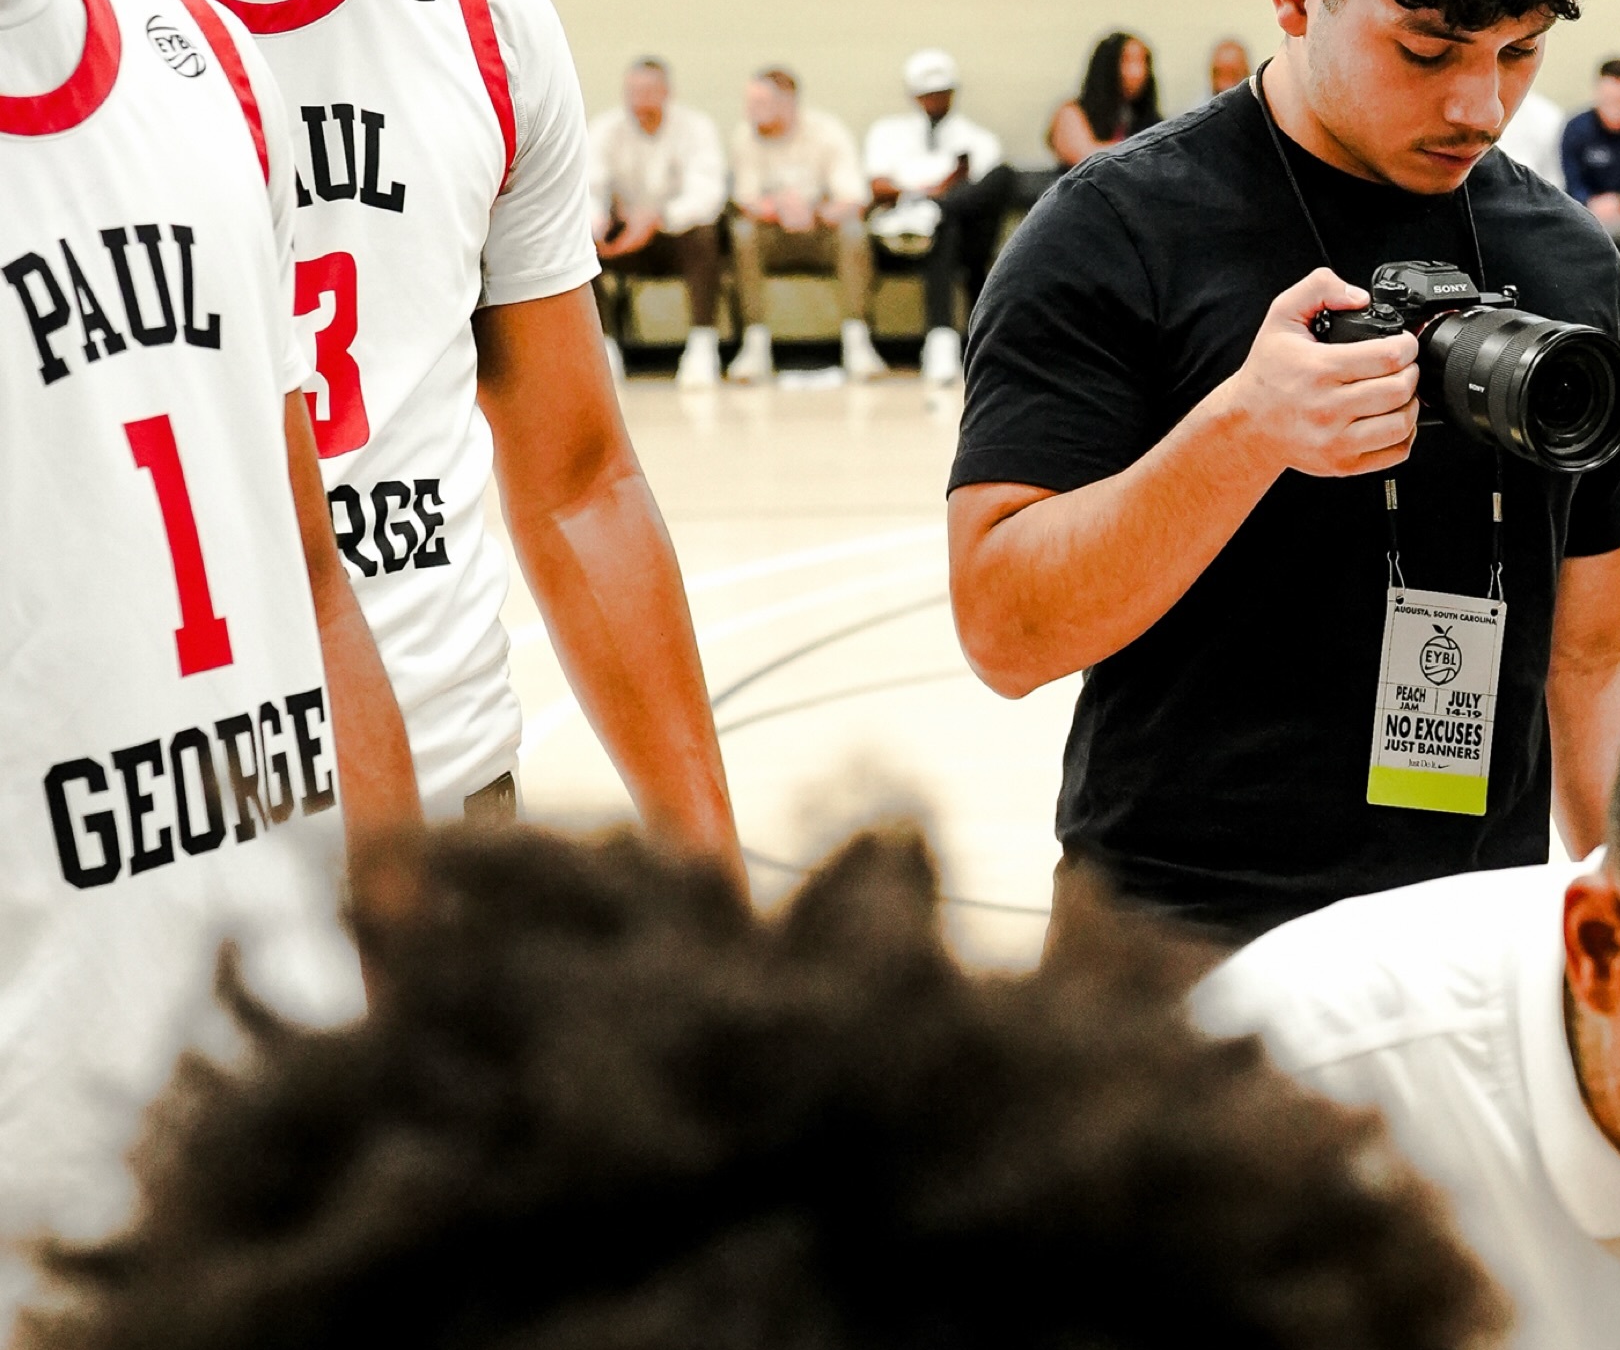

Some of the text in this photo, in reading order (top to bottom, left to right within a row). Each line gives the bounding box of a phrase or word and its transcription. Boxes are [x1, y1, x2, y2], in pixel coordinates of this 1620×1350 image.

[295, 103, 406, 214] UL
[1432, 283, 1468, 294] SONY
[1, 223, 221, 386] PAUL
[293, 251, 371, 460] 3
[327, 478, 451, 578] RGE
[123, 411, 235, 679] 1
[1394, 606, 1497, 626] AUGUSTA, SOUTH CAROLINA
[1425, 649, 1457, 666] EYBL
[1395, 685, 1427, 703] PEACH
[1447, 690, 1482, 710] JULY
[1399, 701, 1419, 711] JAM
[1445, 707, 1482, 719] 14-19
[1385, 713, 1483, 747] NO EXCUSES
[1384, 738, 1481, 761] JUST BANNERS
[43, 686, 337, 890] GEORGE
